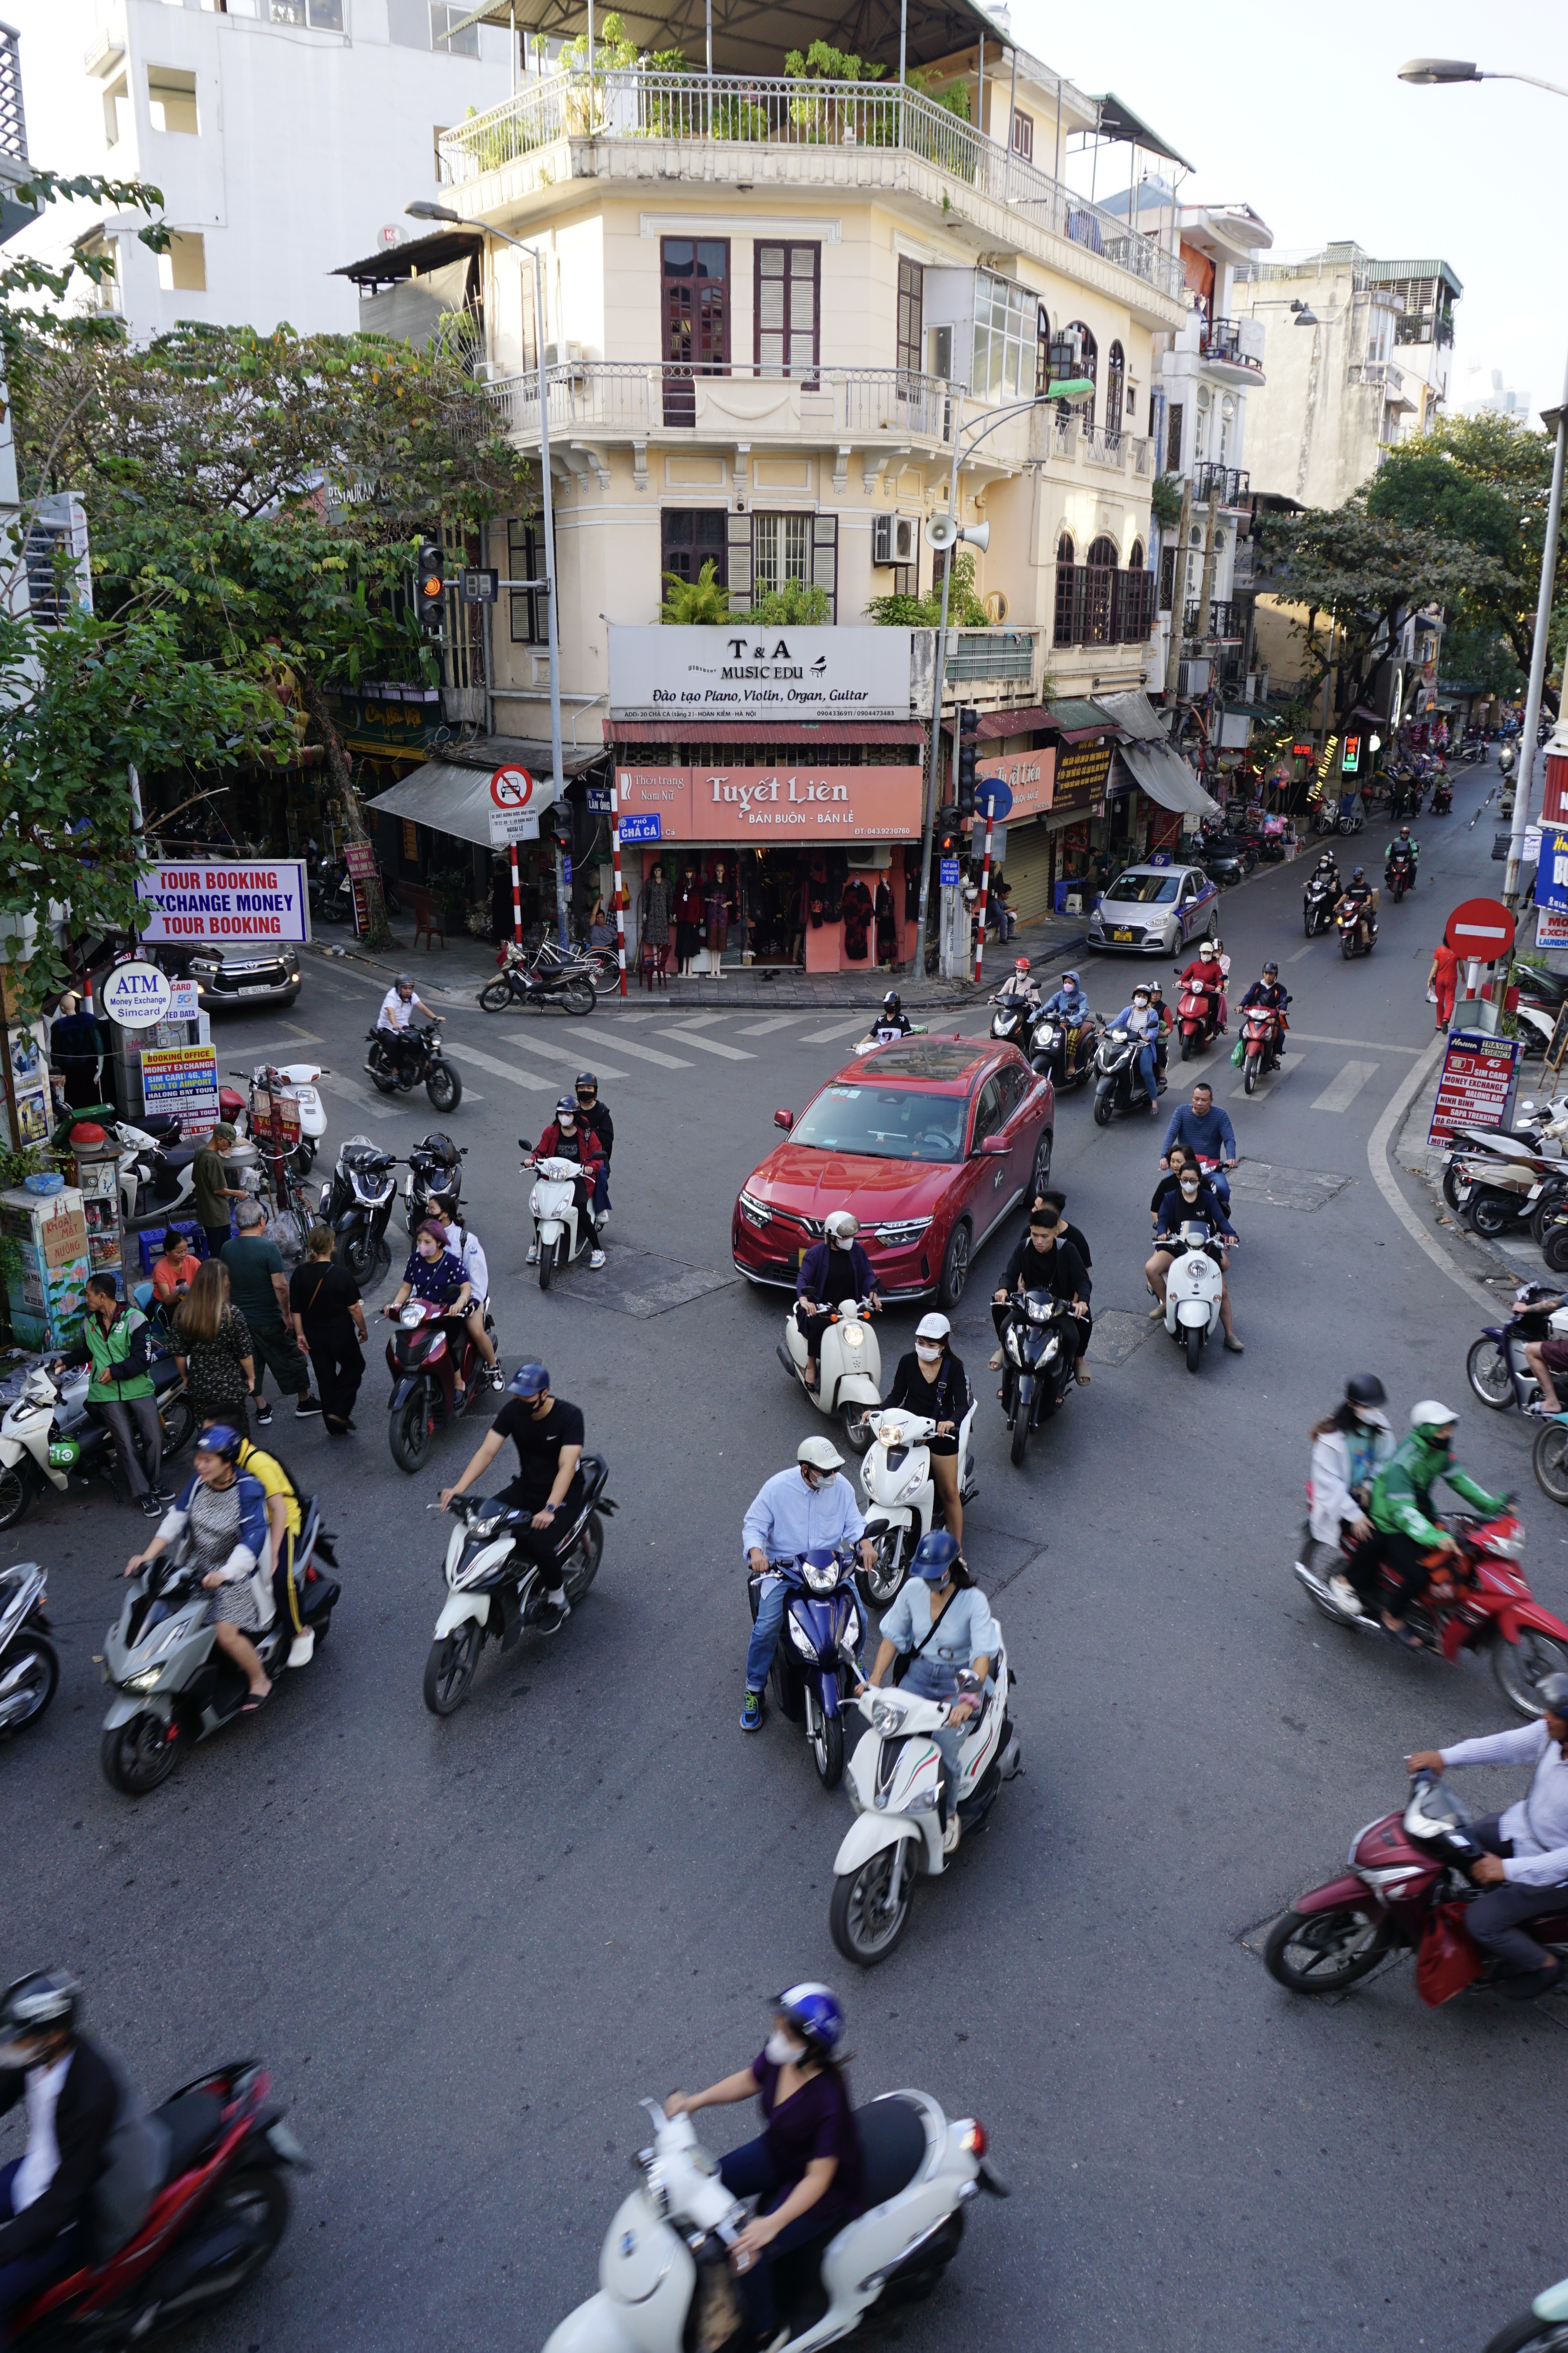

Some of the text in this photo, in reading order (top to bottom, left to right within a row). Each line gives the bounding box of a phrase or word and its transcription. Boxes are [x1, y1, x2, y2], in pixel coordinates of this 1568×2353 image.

[728, 639, 792, 659] T & A
[721, 666, 804, 679] MUSIC EDU
[653, 689, 868, 703] Đào tạo Piano, Violin, Organ, Guitar
[1021, 761, 1041, 786] Liên
[634, 774, 684, 789] Thời trang
[641, 790, 674, 800] Nam Nữ
[706, 776, 849, 819] Tuyết Liên
[600, 799, 610, 810] ÔNG
[749, 809, 854, 823] BÁN BUÔN BÁN LẺ
[622, 824, 657, 838] CHẢ CÁ
[161, 872, 277, 889] TOUR BOOKING
[236, 894, 293, 911] MONEY
[162, 917, 281, 934] TOUR BOOKING
[116, 975, 158, 994] ATM
[118, 1007, 160, 1017] Simcard
[882, 1032, 893, 1041] 7
[1451, 1038, 1478, 1049] Hanna
[1483, 1040, 1512, 1051] TRAVEL
[147, 1050, 210, 1063] BOOKING OFFICE
[1481, 1048, 1510, 1059] AGENCY
[144, 1060, 214, 1074] MONEY EXCHANGE
[1486, 1059, 1501, 1068] 4G
[147, 1075, 163, 1083] SIM
[165, 1073, 186, 1081] CARD
[1474, 1068, 1508, 1081] SIM CARD
[179, 1078, 212, 1088] AIRPORT
[1444, 1075, 1504, 1091] MONEY EXCHANGE
[1465, 1090, 1490, 1100] HALONG
[1440, 1096, 1475, 1108] NINH BINH
[1450, 1108, 1499, 1123] SAPA TREKKING
[62, 1224, 78, 1238] MẬT
